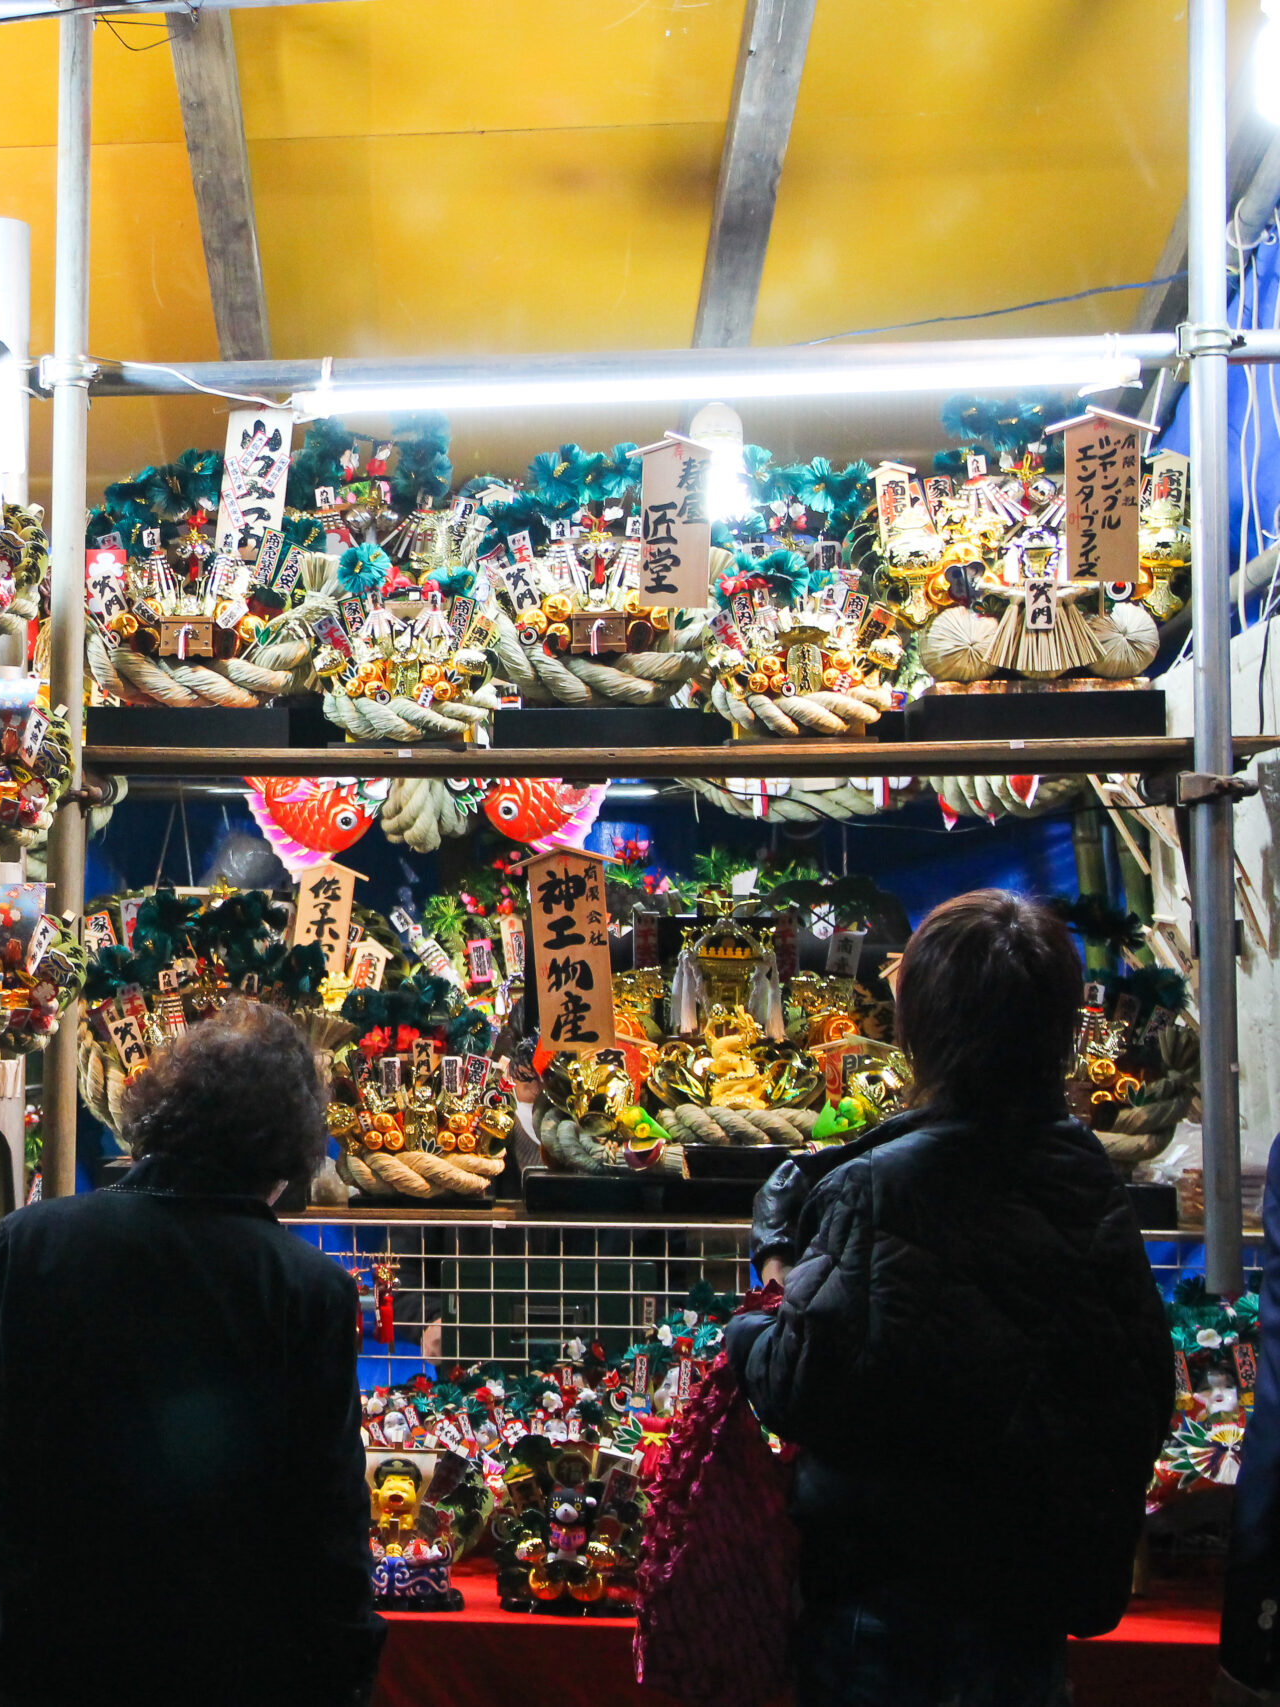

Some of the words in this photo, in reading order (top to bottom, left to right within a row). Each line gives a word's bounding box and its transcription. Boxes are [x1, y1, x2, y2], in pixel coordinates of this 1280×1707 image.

[643, 502, 681, 593] 匠堂
[92, 575, 125, 616] 笑門
[506, 568, 537, 609] 笑門
[1030, 583, 1053, 625] 笑門
[584, 862, 607, 947] 有限会社
[537, 869, 599, 1043] 神工物産
[113, 1021, 143, 1065] 笑門
